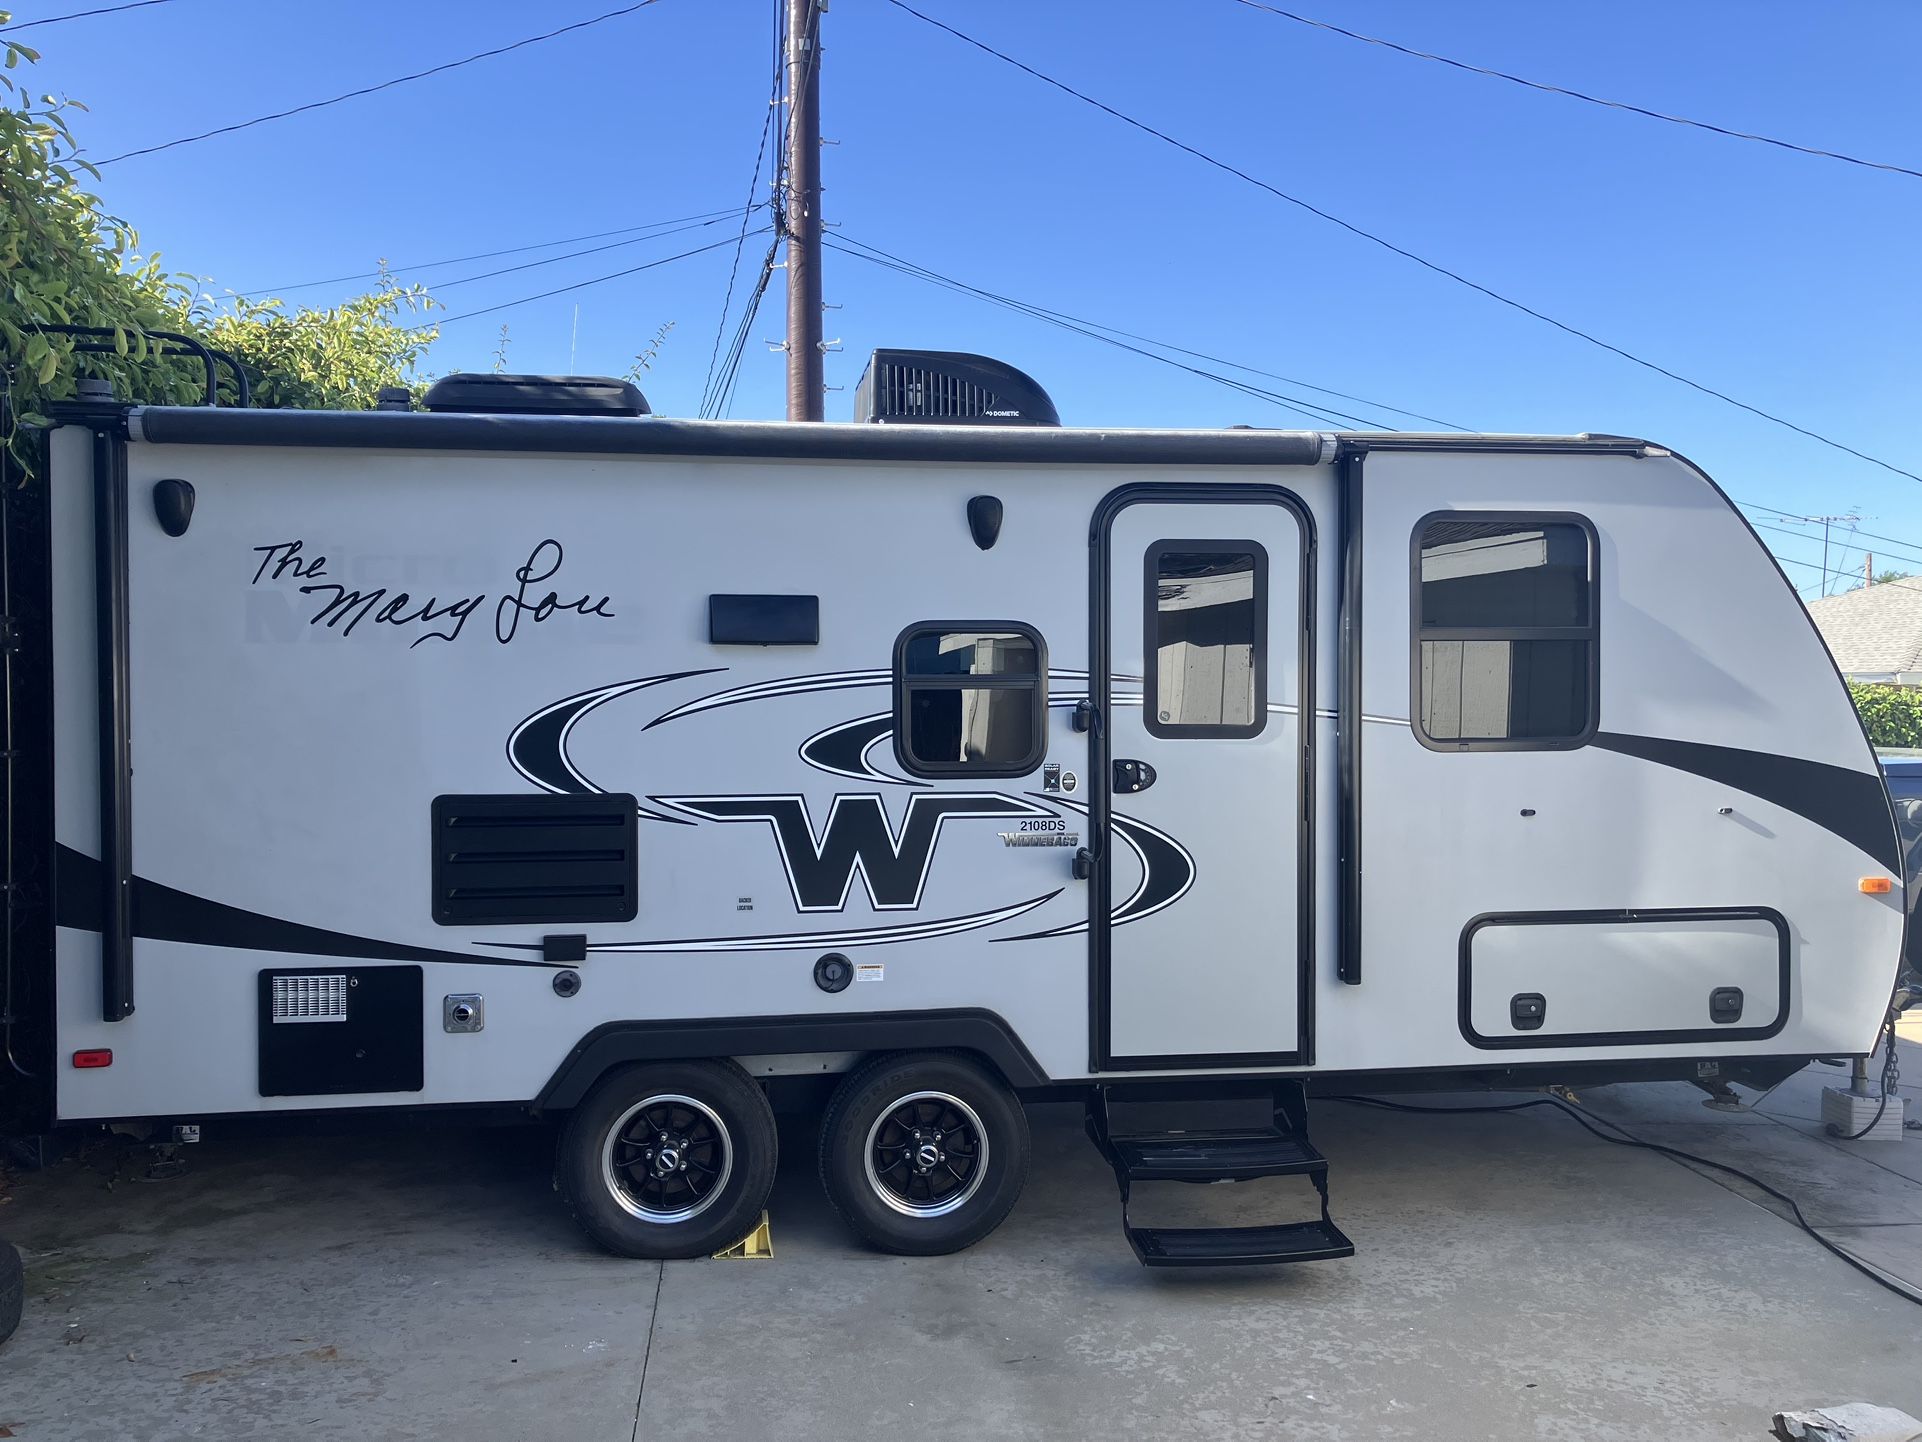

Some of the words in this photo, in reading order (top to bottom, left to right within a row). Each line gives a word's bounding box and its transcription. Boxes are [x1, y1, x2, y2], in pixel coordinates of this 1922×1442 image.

[252, 539, 328, 585] The
[299, 583, 486, 649] Mary
[495, 538, 616, 645] Lou
[1020, 820, 1066, 831] 2108DS
